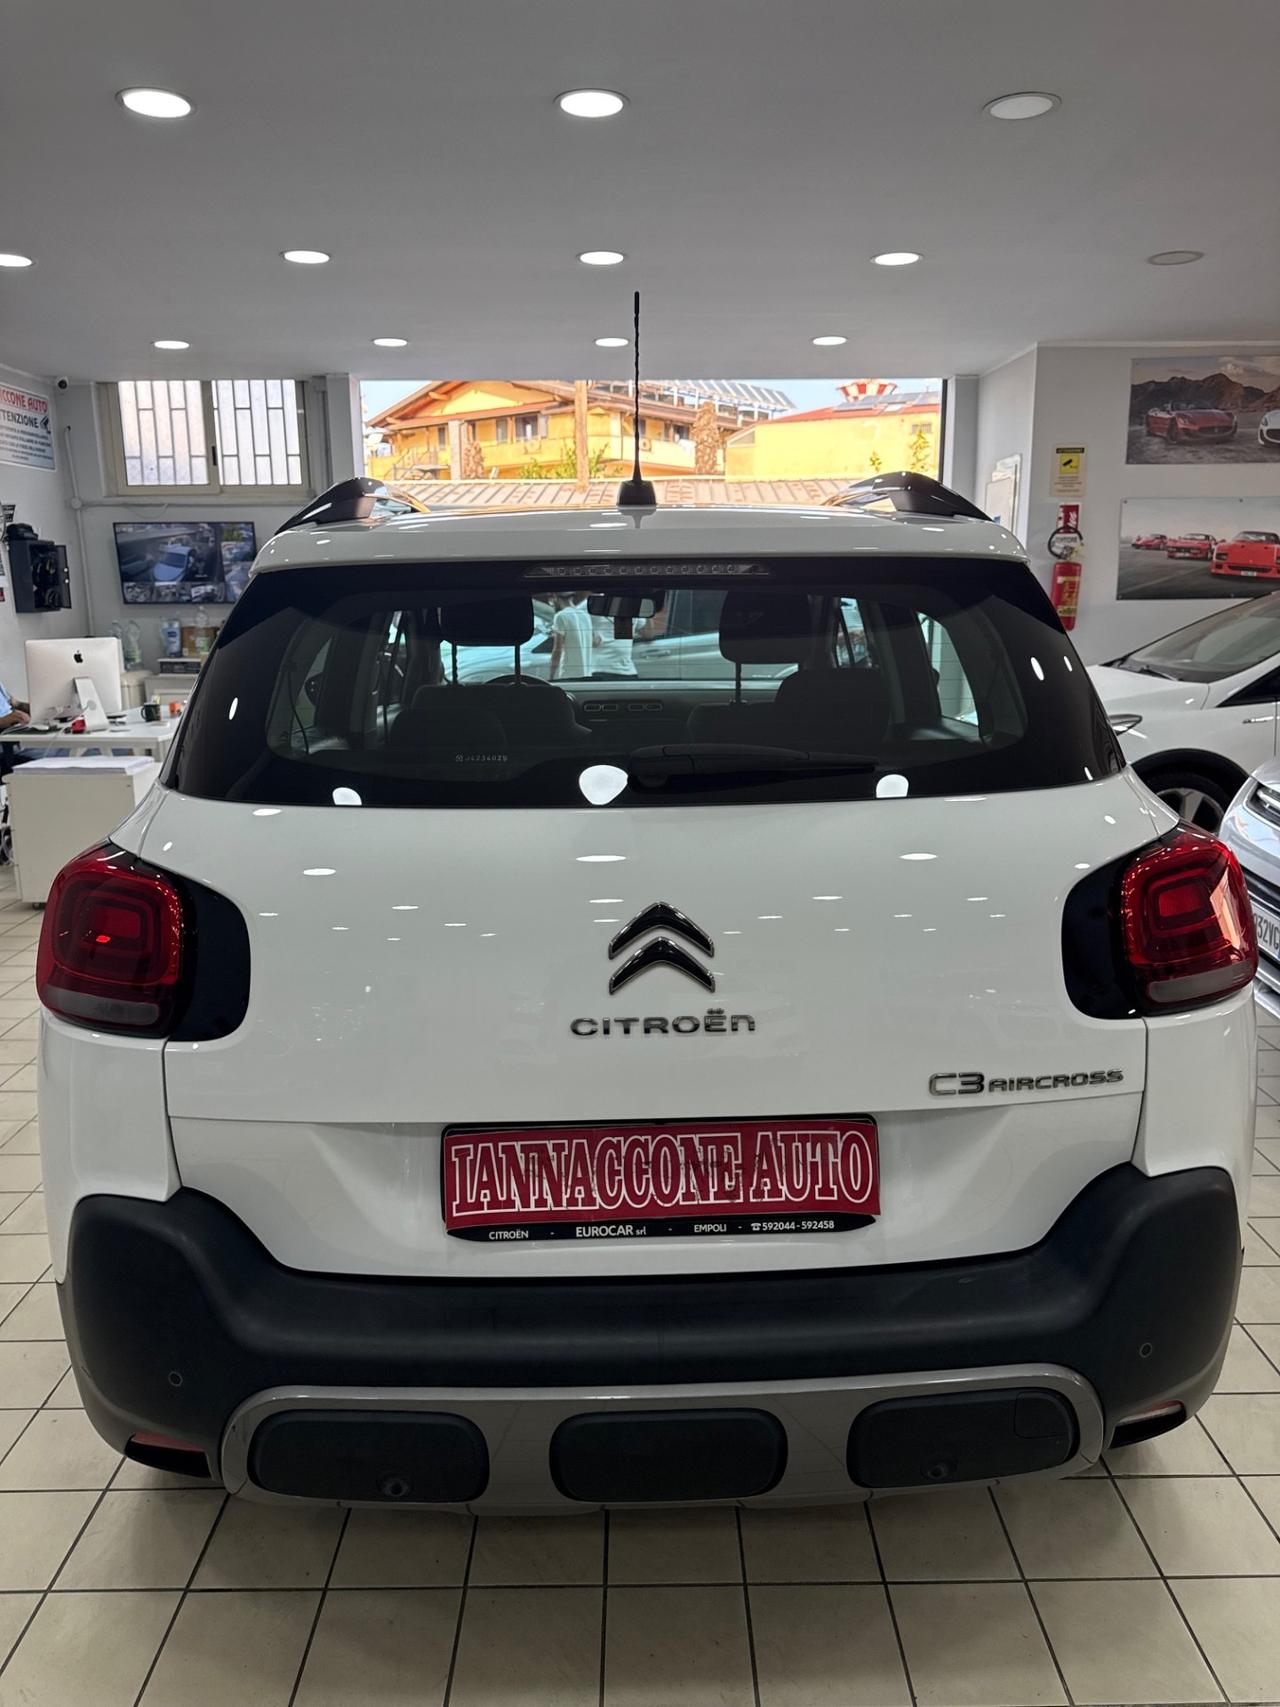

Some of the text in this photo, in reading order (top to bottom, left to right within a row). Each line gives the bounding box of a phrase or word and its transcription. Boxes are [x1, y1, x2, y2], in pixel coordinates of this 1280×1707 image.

[28, 397, 48, 413] AUTO
[929, 1069, 1124, 1096] C3 AIRCROSS
[452, 1130, 873, 1216] IANNACCONE AUTO
[489, 1229, 529, 1240] CITROËN
[576, 1225, 633, 1238] EUROCAR
[635, 1226, 647, 1236] srl
[694, 1224, 727, 1233] EMPOLI
